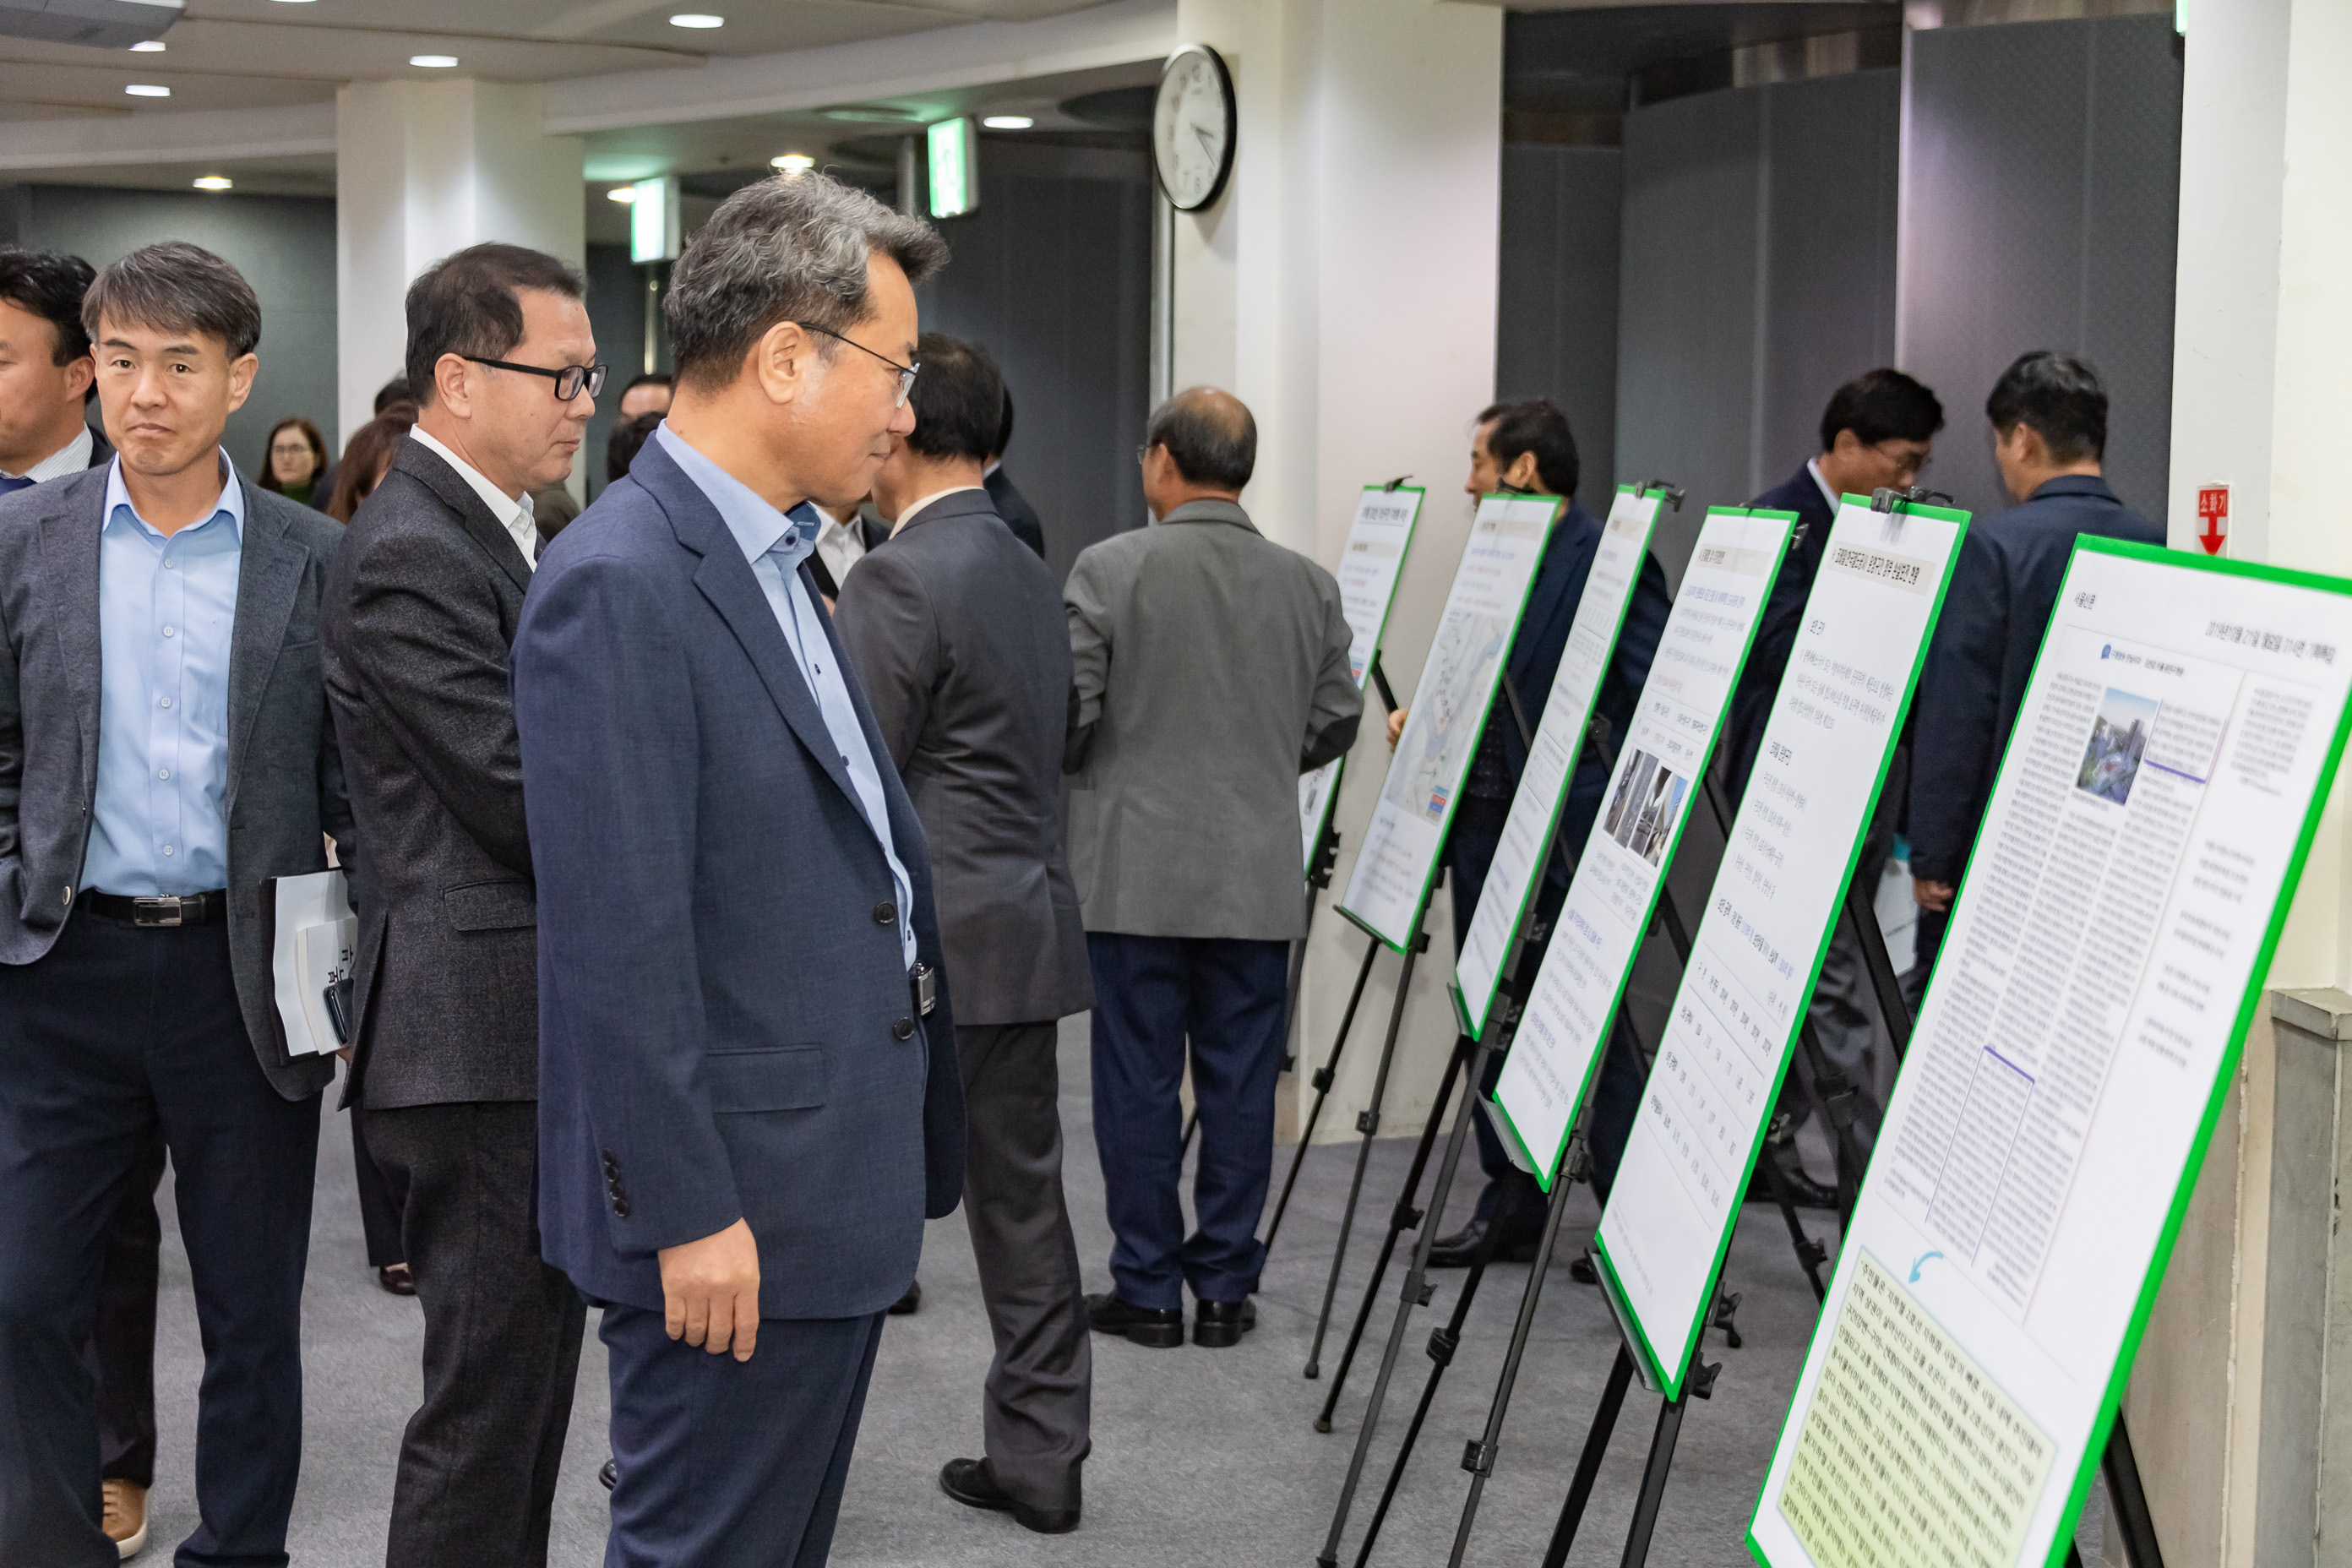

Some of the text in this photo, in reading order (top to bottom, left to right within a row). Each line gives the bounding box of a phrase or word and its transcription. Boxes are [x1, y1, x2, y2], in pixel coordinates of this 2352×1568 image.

[2200, 492, 2226, 514] 소화기
[2074, 591, 2096, 610] 서울신문
[1852, 1282, 1865, 1302] 지역
[1865, 1296, 1883, 1320] 상권이
[1905, 1309, 1922, 1333] 2호선
